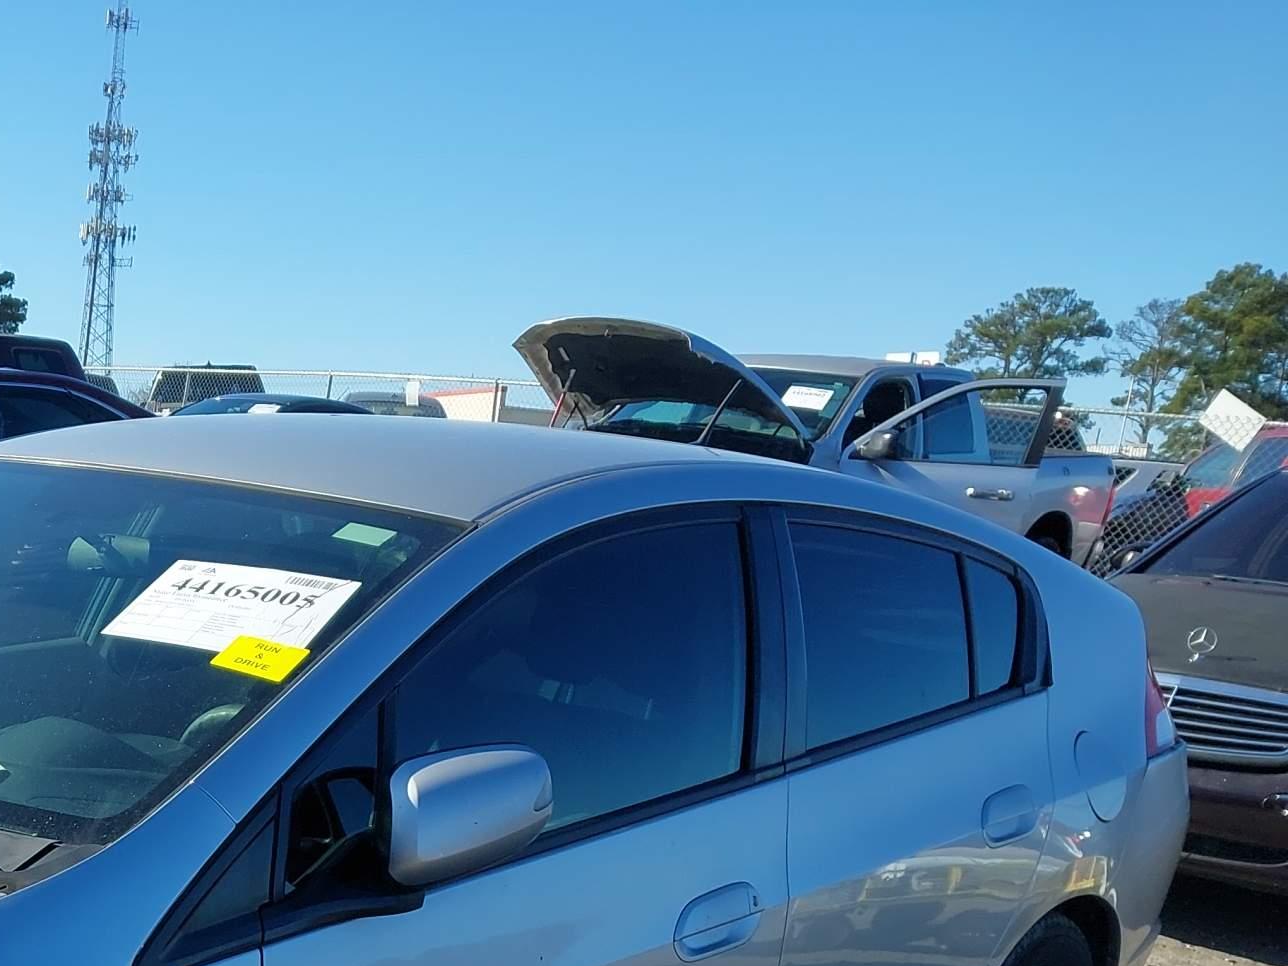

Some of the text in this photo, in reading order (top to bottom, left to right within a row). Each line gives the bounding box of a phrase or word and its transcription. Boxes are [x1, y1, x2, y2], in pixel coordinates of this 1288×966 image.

[171, 578, 316, 608] 44165005
[254, 642, 282, 654] RUN
[233, 656, 271, 671] DRIVE
